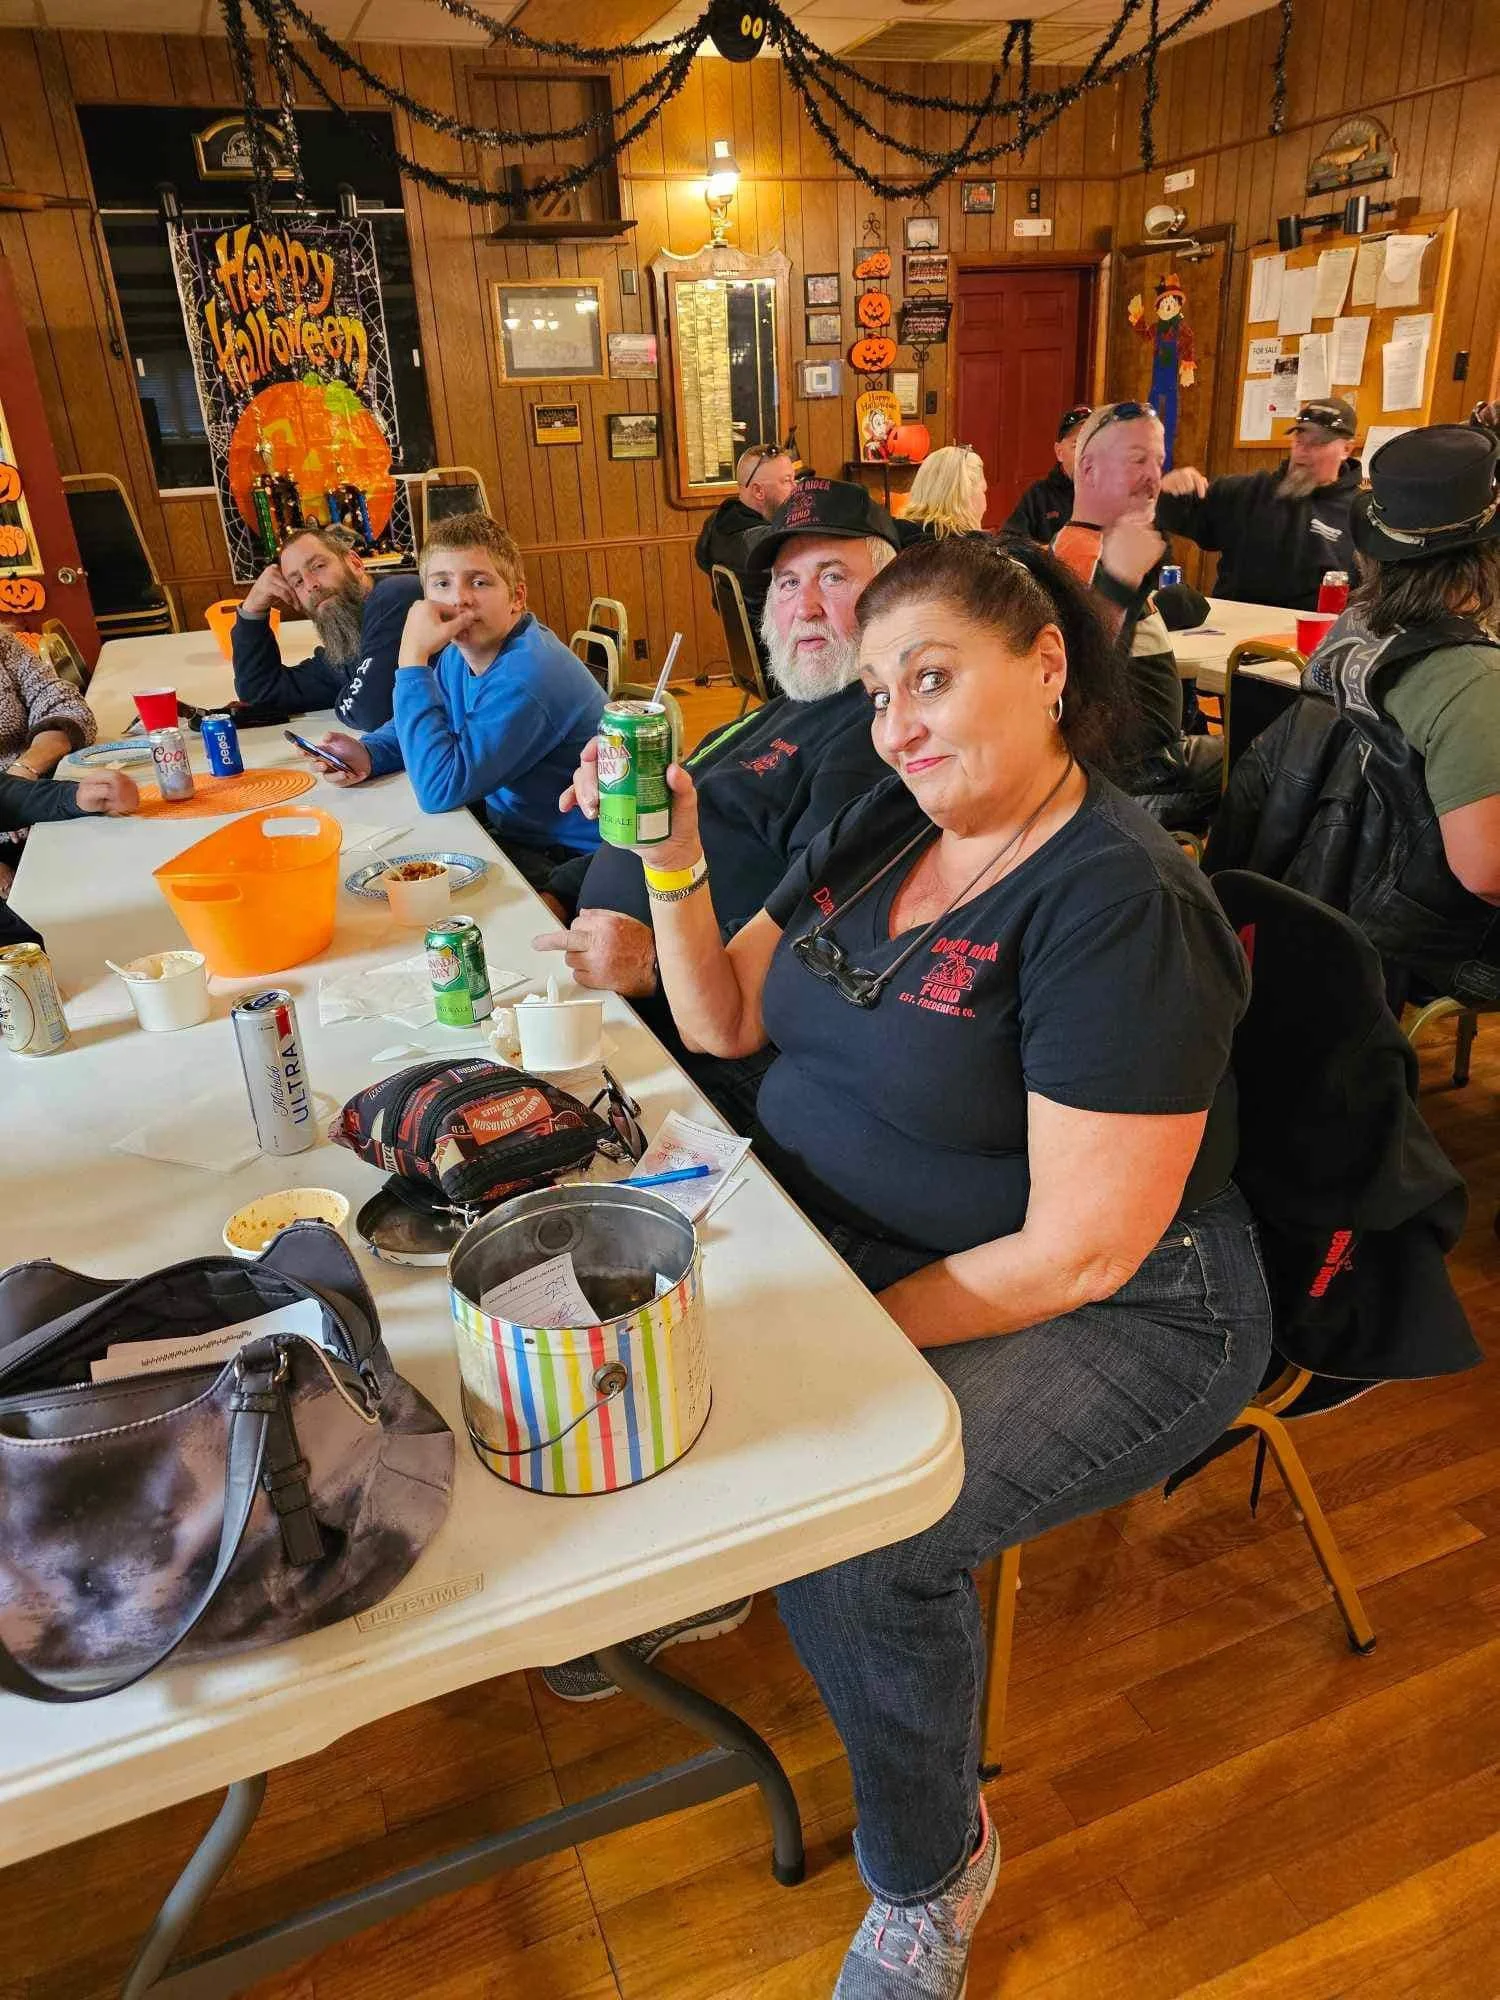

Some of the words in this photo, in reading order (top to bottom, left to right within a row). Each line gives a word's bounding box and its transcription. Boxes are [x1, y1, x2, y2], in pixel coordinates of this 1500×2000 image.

[215, 224, 334, 316] Happy
[204, 296, 368, 395] Halloween
[1265, 346, 1278, 354] SALE
[868, 392, 891, 402] Happy
[804, 479, 831, 491] RIDER
[214, 731, 234, 766] pepsi
[899, 992, 916, 1005] EST.
[917, 997, 960, 1017] FREDERICK
[962, 1008, 976, 1018] CO.
[920, 983, 960, 1003] FUND
[281, 1041, 309, 1125] ULTRA
[471, 1095, 541, 1133] HARLEY-DAVIDSON
[369, 1583, 467, 1624] LIFETIME
